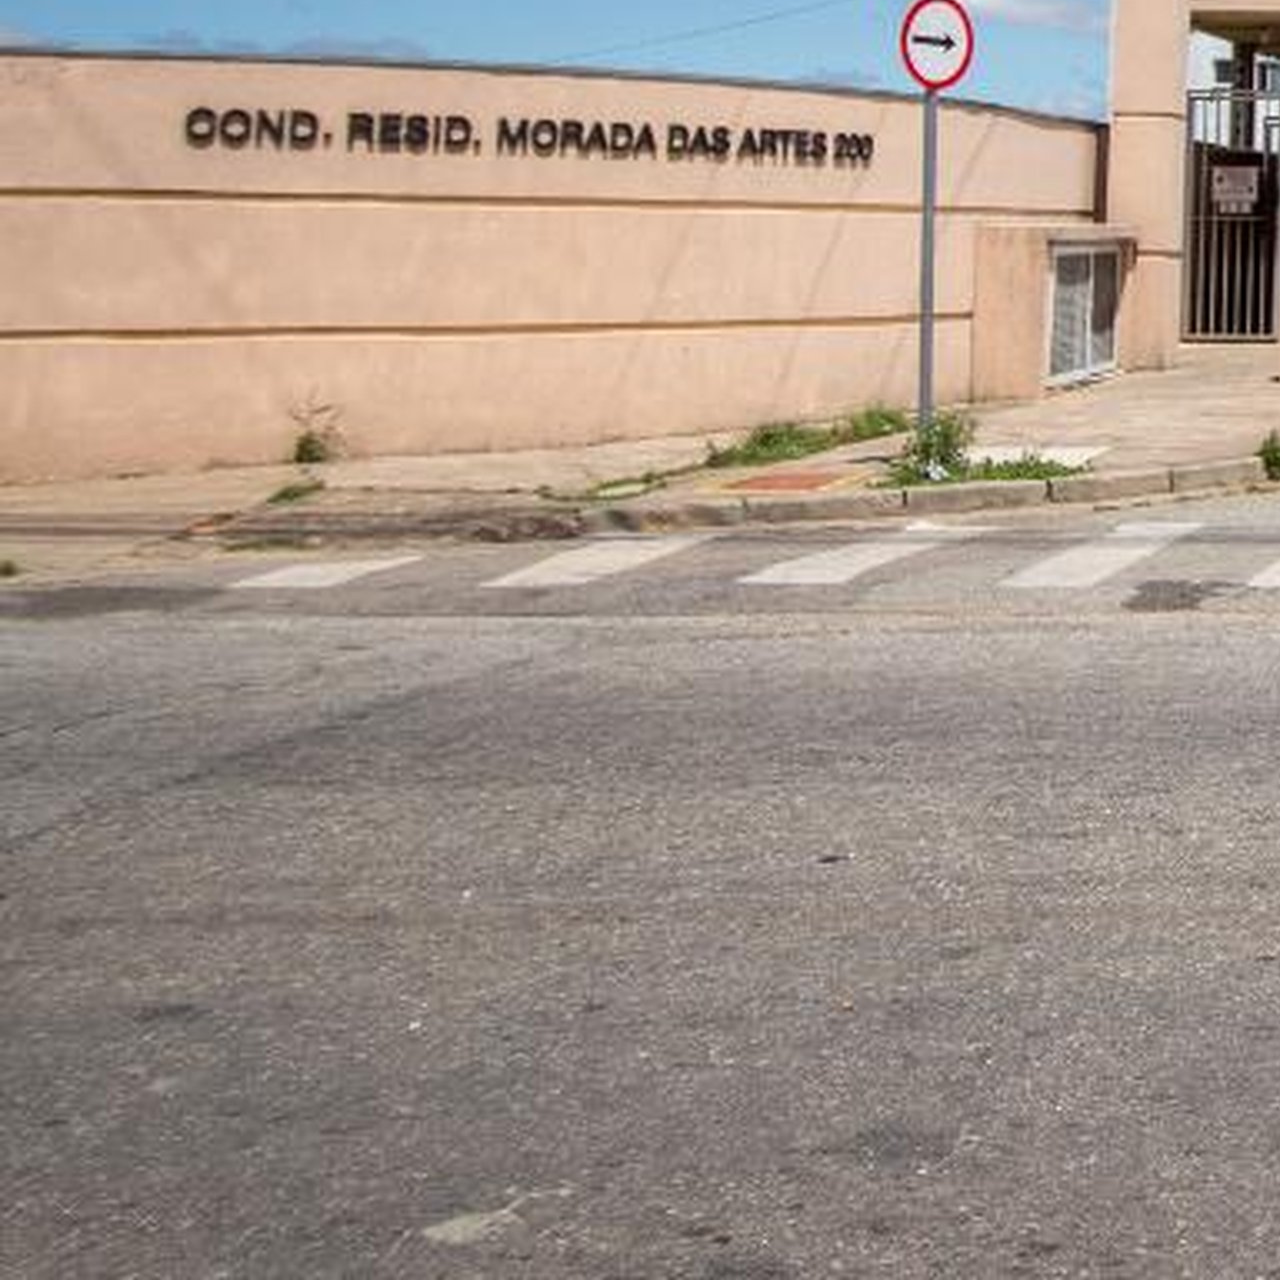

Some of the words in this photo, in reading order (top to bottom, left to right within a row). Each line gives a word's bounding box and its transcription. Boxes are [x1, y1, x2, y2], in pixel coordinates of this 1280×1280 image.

[185, 107, 333, 150] COND.
[347, 112, 482, 156] RESID.
[496, 119, 656, 160] MORADA
[666, 123, 732, 163] DAS
[737, 128, 828, 167] ARTES
